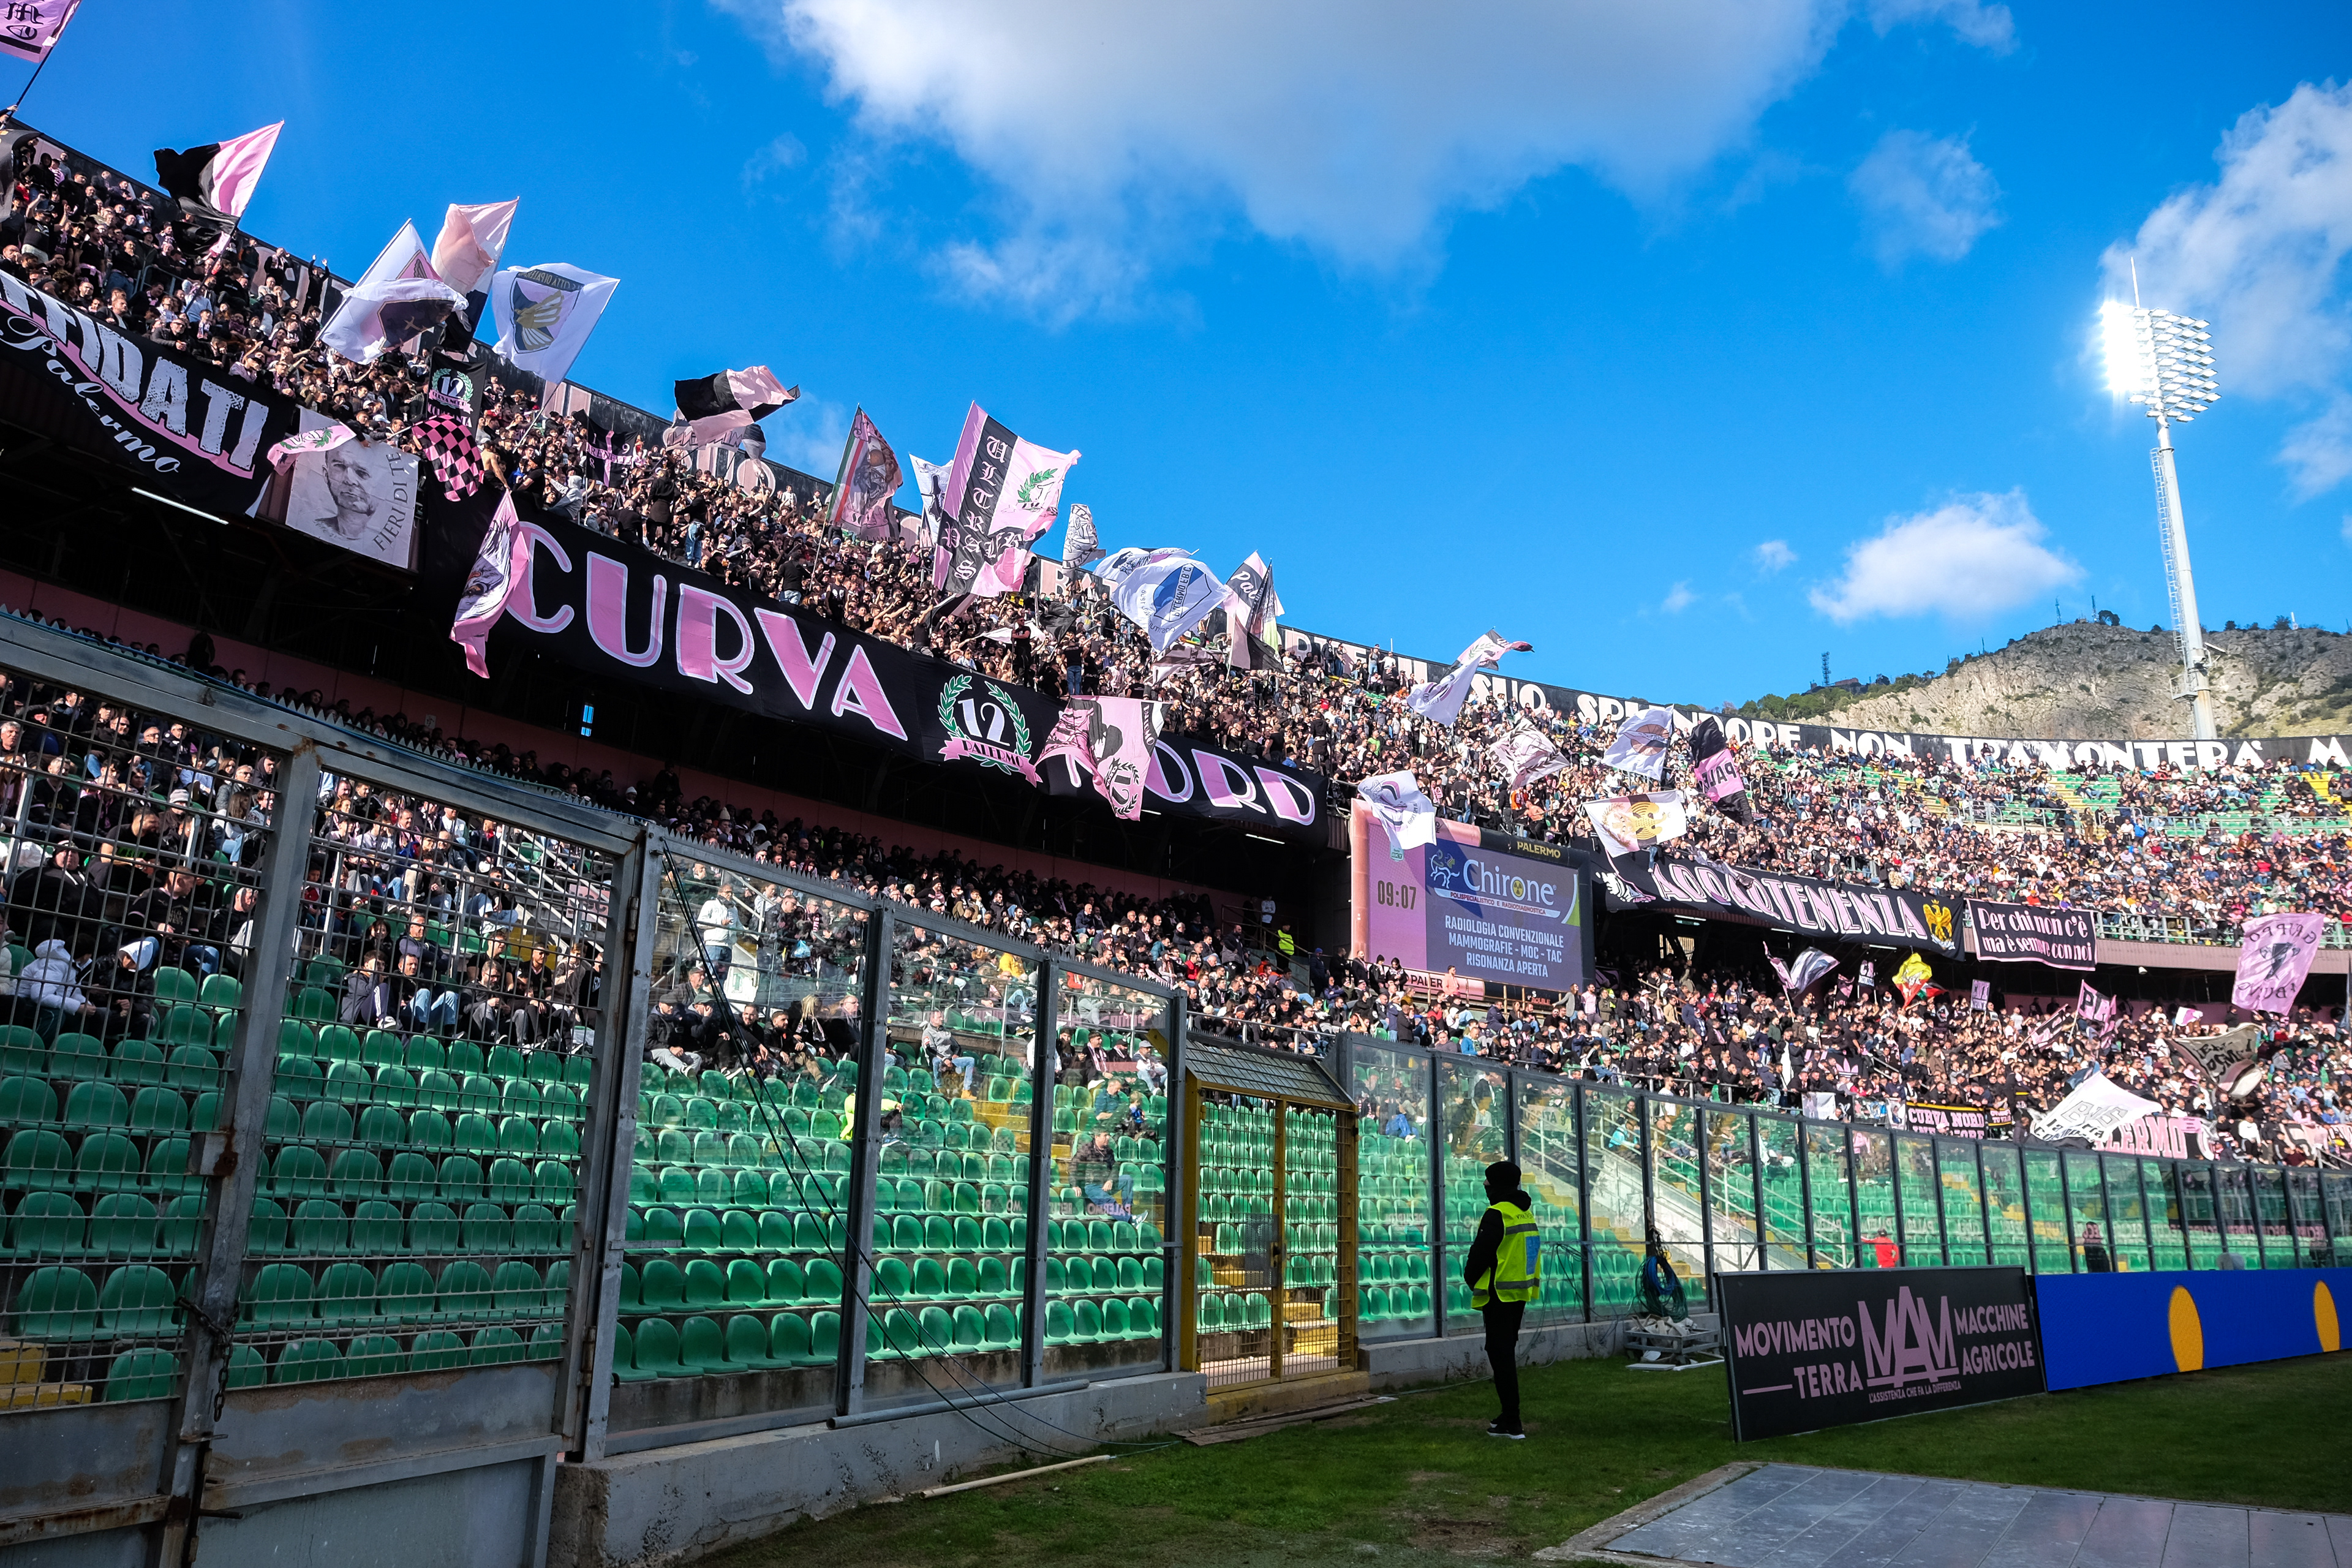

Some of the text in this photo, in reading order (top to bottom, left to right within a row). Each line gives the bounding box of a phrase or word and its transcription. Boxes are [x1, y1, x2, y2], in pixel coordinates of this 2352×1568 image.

[0, 268, 269, 471] FFIDATI
[372, 451, 409, 552] FIERI DI TE
[503, 521, 908, 742] CURVA
[957, 698, 1011, 747] 12
[1470, 673, 1547, 715] SUO
[1830, 727, 1911, 760] NON
[962, 739, 1024, 769] PALERMO
[1516, 840, 1561, 859] PALERMO
[1378, 880, 1417, 910] 09:07
[1463, 859, 1555, 906] Chirone
[1450, 891, 1494, 905] POLISPECIALISTICO
[1502, 903, 1546, 915] RADIODIAGNOSTICA
[1445, 914, 1564, 949] RADIOLOGIA CONVENZIONALE
[1977, 907, 2006, 931] Per
[2008, 910, 2035, 931] chi
[2032, 915, 2064, 937] non
[1449, 932, 1513, 956] MAMMOGRAFIE
[1520, 944, 1539, 959] MOC
[1546, 948, 1562, 963] TAC
[1981, 936, 2006, 953] ma
[2051, 942, 2073, 960] con
[2073, 941, 2092, 961] noi
[1410, 974, 1443, 989] PALER
[1466, 952, 1548, 978] RISONANZA APERTA
[1908, 1107, 1950, 1127] CURVA
[1950, 1112, 1985, 1128] NORD
[2092, 1115, 2188, 1160] LERMO
[1734, 1315, 1856, 1358] MOVIMENTO
[1953, 1303, 2029, 1336] MACCHINE
[1856, 1285, 1960, 1389] MAM
[1962, 1340, 2035, 1376] AGRICOLE
[1793, 1360, 1864, 1400] TERRA
[1868, 1380, 1962, 1404] L'ASSISTENZA CHE FA LA DIFFERENZA
